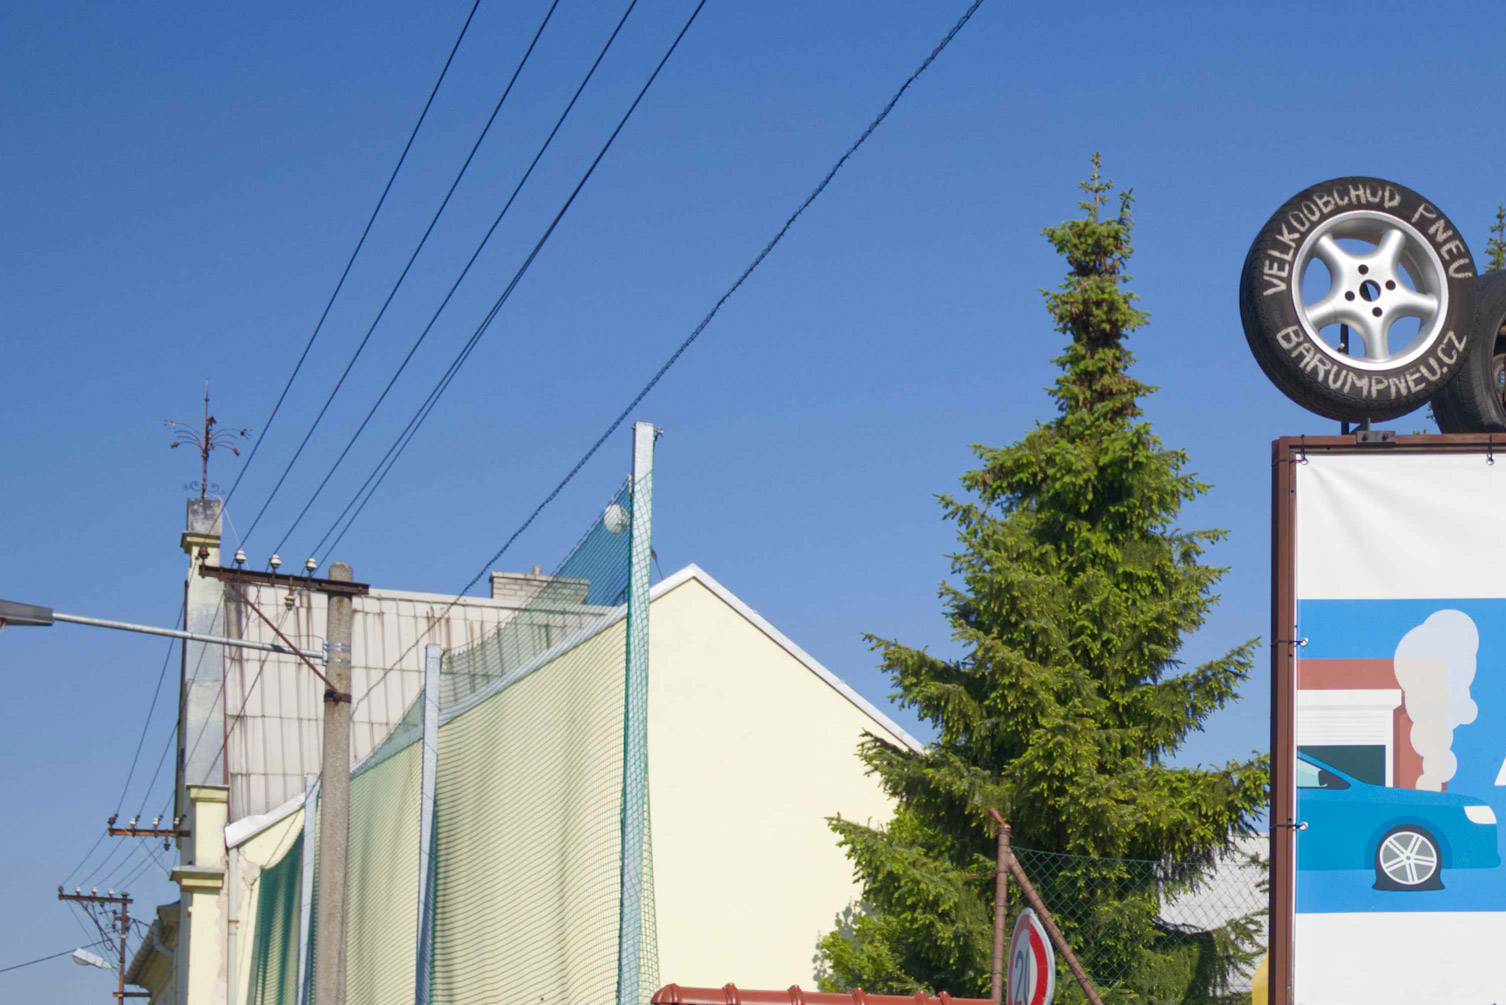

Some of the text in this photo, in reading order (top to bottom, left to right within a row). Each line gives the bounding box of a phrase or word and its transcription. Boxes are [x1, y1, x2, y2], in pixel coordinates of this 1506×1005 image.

[1264, 183, 1474, 296] VELKOOBCHOD PNEU
[1276, 325, 1467, 400] BARUMPNEU.CZ
